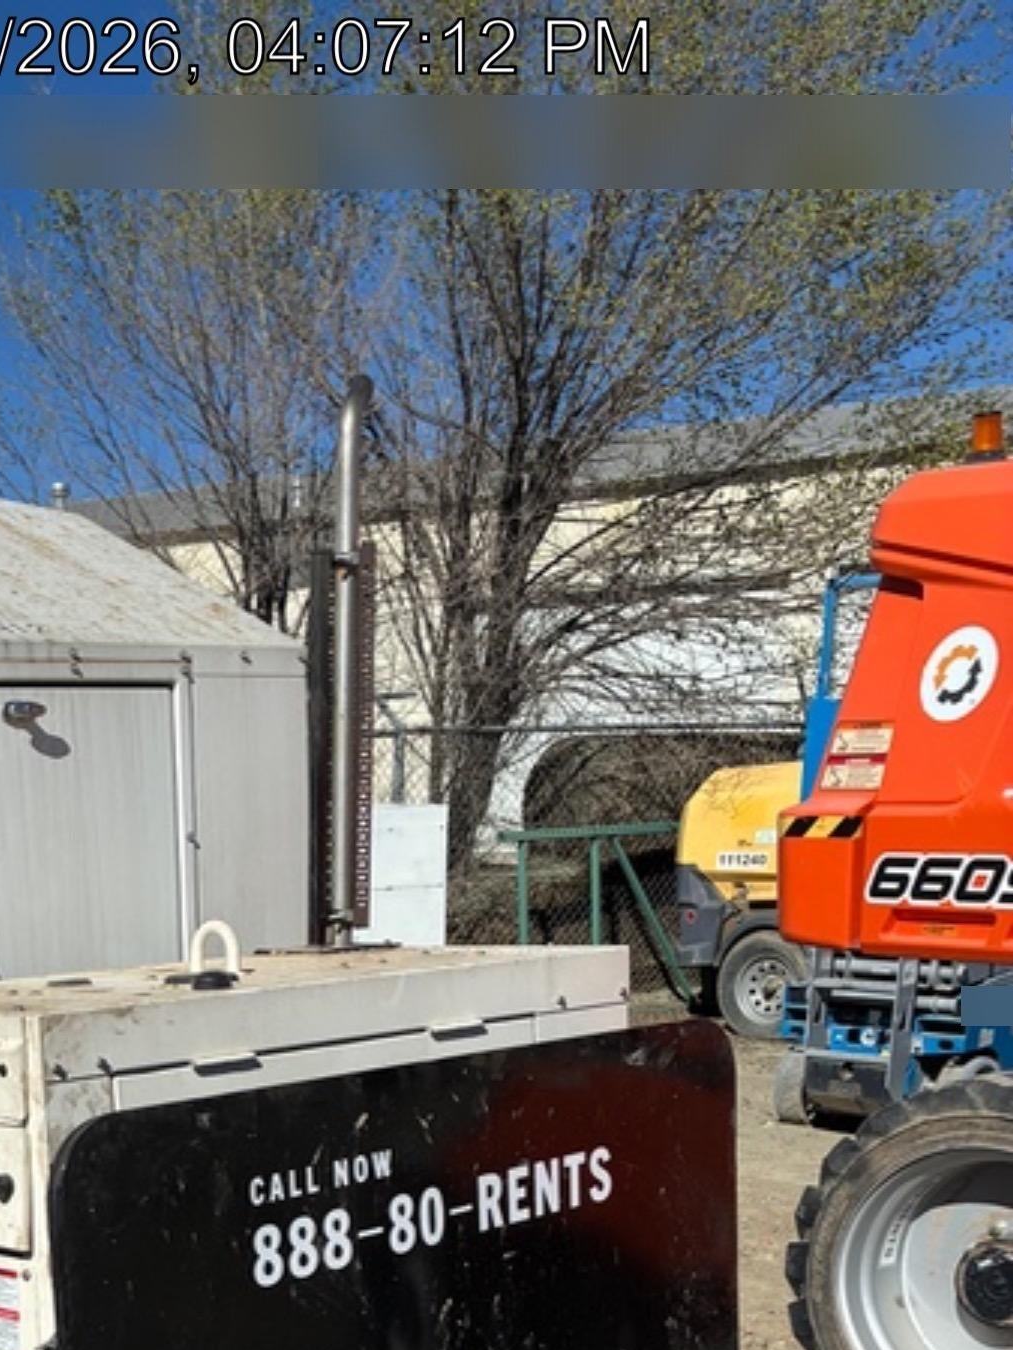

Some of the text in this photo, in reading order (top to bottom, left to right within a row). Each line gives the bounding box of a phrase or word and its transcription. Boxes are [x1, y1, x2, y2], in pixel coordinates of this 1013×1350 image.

[719, 853, 768, 866] 111240
[249, 1148, 394, 1207] CALL NOW
[252, 1144, 614, 1288] 888-80-RENTS
